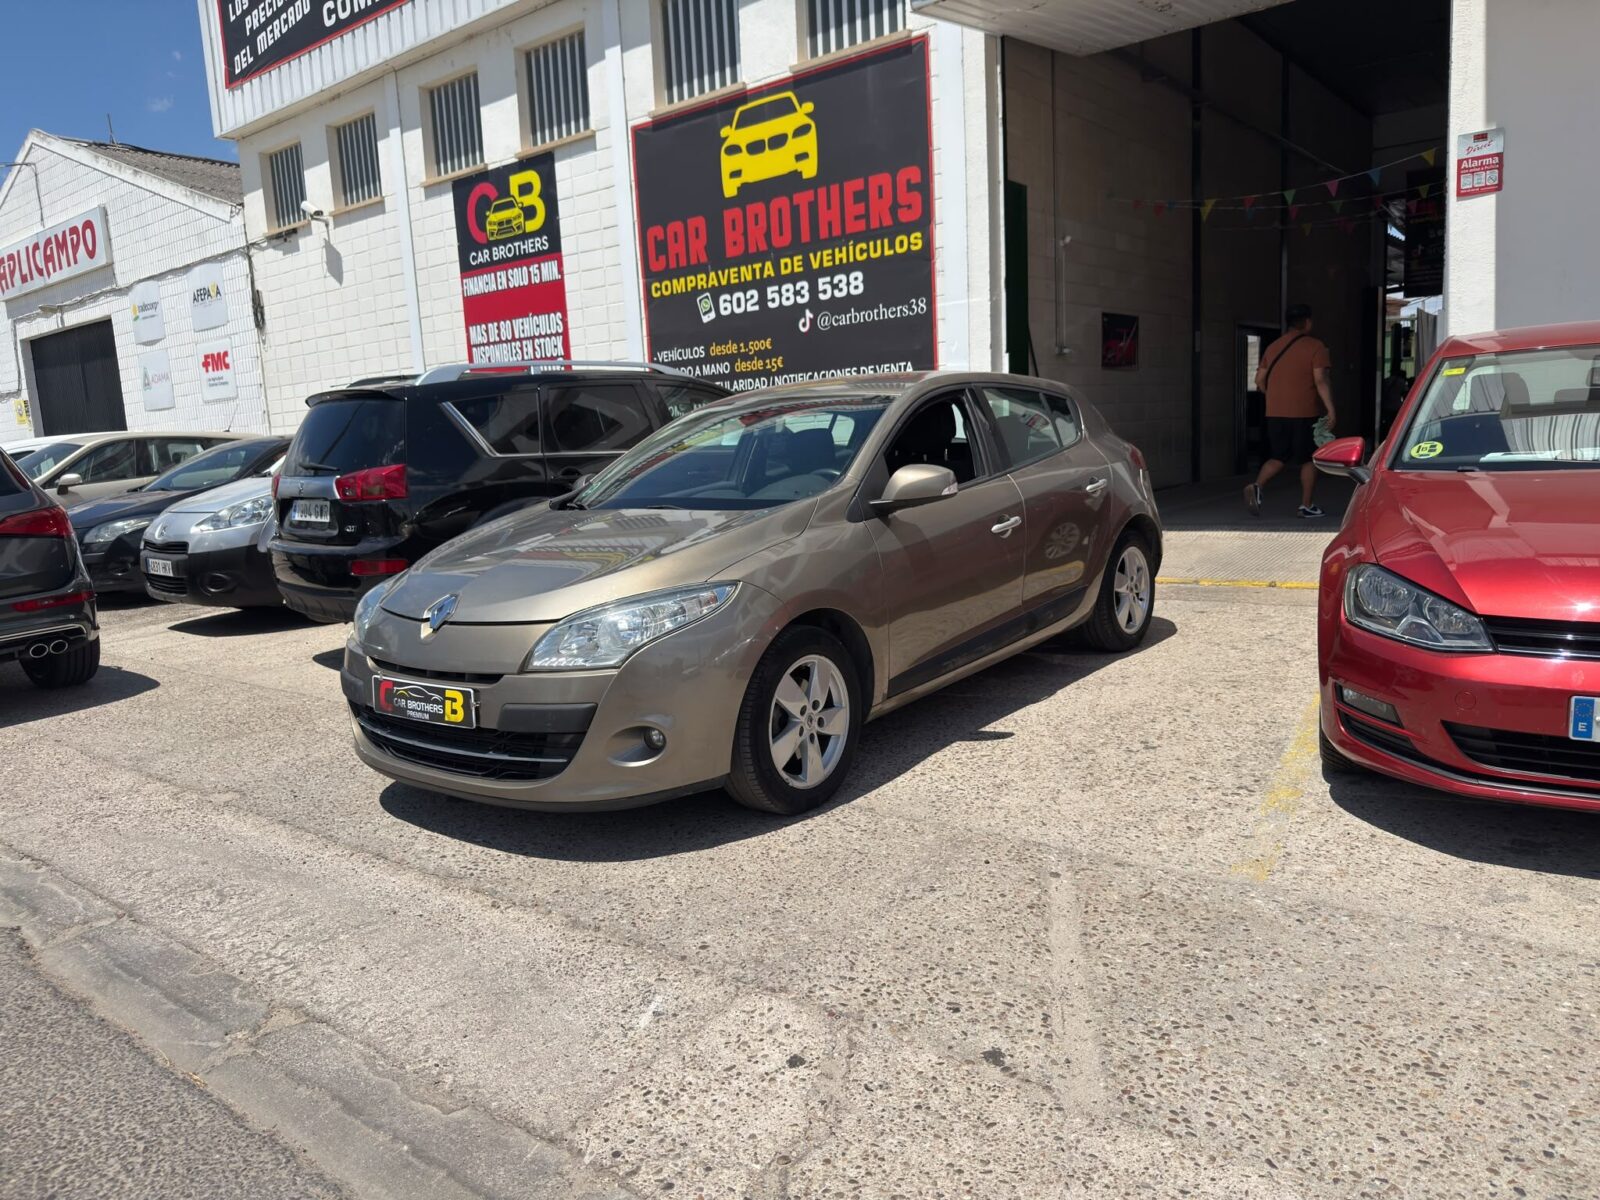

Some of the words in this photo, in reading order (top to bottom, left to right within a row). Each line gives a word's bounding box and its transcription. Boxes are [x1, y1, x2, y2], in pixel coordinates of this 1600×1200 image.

[234, 45, 254, 75] DEL
[257, 0, 310, 55] MERCADO
[1461, 157, 1499, 169] Alarma
[647, 215, 709, 272] CAR
[723, 165, 923, 259] BROTHERS
[0, 219, 96, 296] APLICAMPO
[469, 249, 491, 266] CAR
[492, 235, 549, 261] BROTHERS
[651, 264, 775, 298] COMPRAVENTA
[780, 255, 803, 275] DE
[809, 232, 923, 268] VEHÍCULOS
[463, 272, 497, 297] FINANCIA
[496, 270, 508, 290] EN
[508, 266, 529, 289] SOLO
[529, 264, 541, 284] 15
[540, 260, 562, 282] MIN.
[719, 289, 759, 316] 602
[767, 280, 809, 308] 583
[817, 271, 864, 300] 538
[469, 323, 488, 345] MAS
[487, 321, 500, 343] DE
[500, 319, 513, 341] 80
[512, 312, 563, 339] VEHÍCULOS
[817, 297, 927, 330] @carbrothers38
[202, 351, 230, 373] FMC
[472, 341, 523, 364] DISPONIBLES
[522, 340, 534, 360] EN
[534, 335, 564, 359] STOCK
[710, 340, 738, 356] desde
[739, 338, 772, 355] 1.500€
[695, 365, 701, 377] A
[702, 362, 730, 376] MANO
[735, 357, 763, 372] desde
[765, 356, 784, 372] 15€
[774, 367, 857, 386] NOTIFICACIONES
[860, 366, 874, 375] DE
[876, 361, 913, 373] VENTA
[393, 697, 406, 707] CAR
[407, 700, 444, 714] BROTHERS
[406, 710, 430, 720] PREMIUM
[1578, 722, 1588, 731] E
